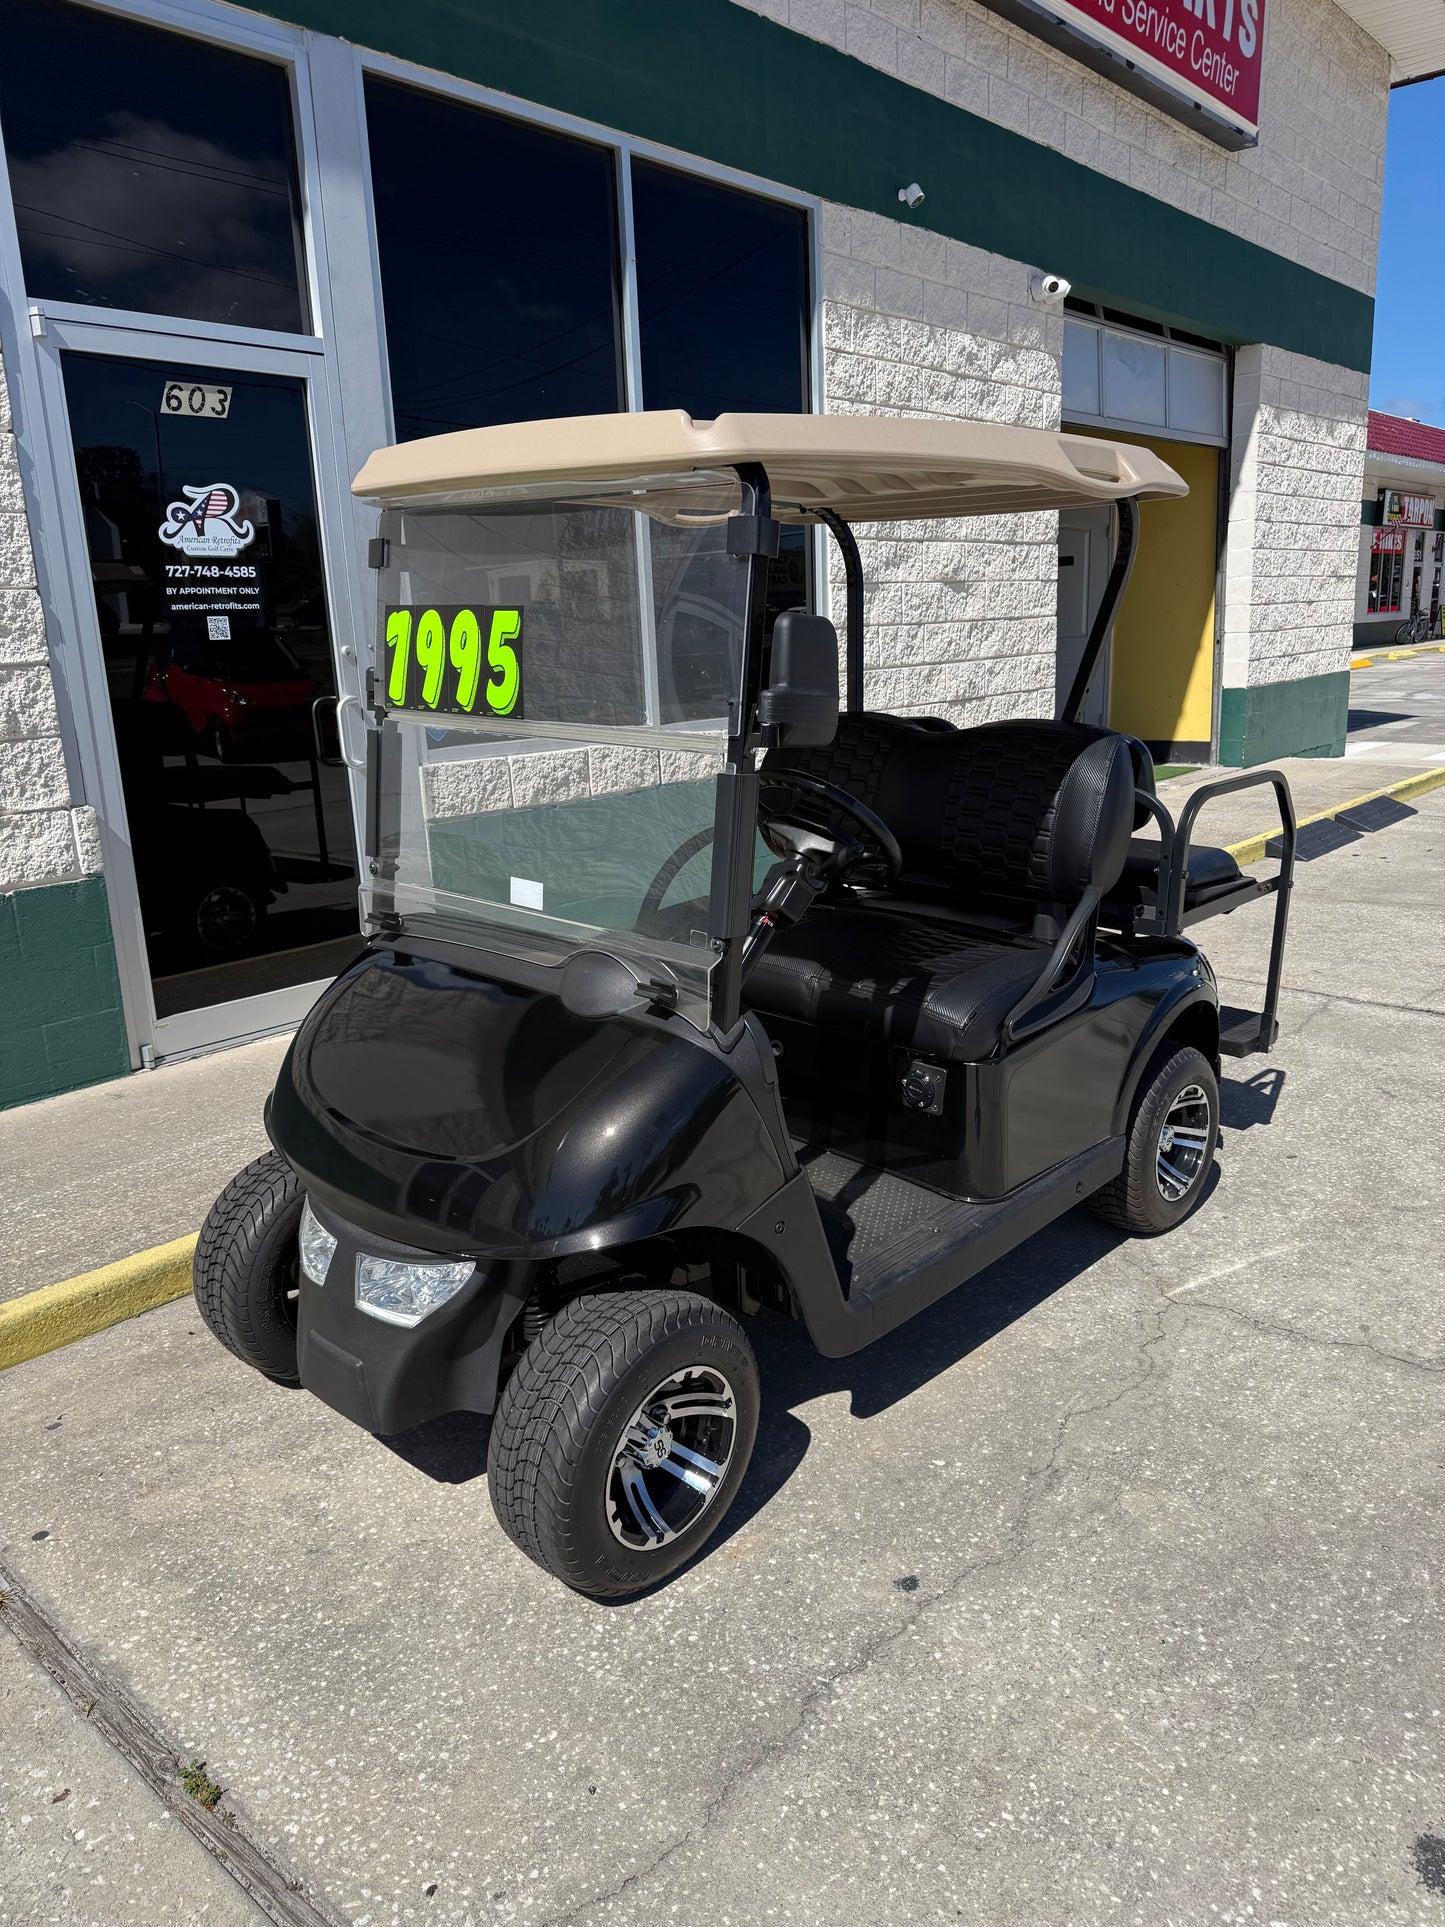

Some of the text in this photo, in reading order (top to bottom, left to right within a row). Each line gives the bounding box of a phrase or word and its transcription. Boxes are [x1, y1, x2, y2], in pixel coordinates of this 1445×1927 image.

[1122, 0, 1239, 95] Service Center
[165, 383, 229, 417] 603
[177, 535, 241, 547] American Retrofits
[165, 565, 256, 578] 727-748-4585
[166, 587, 260, 595] BY APPOINTMENT ONLY
[171, 602, 260, 611] american-retrofits.com
